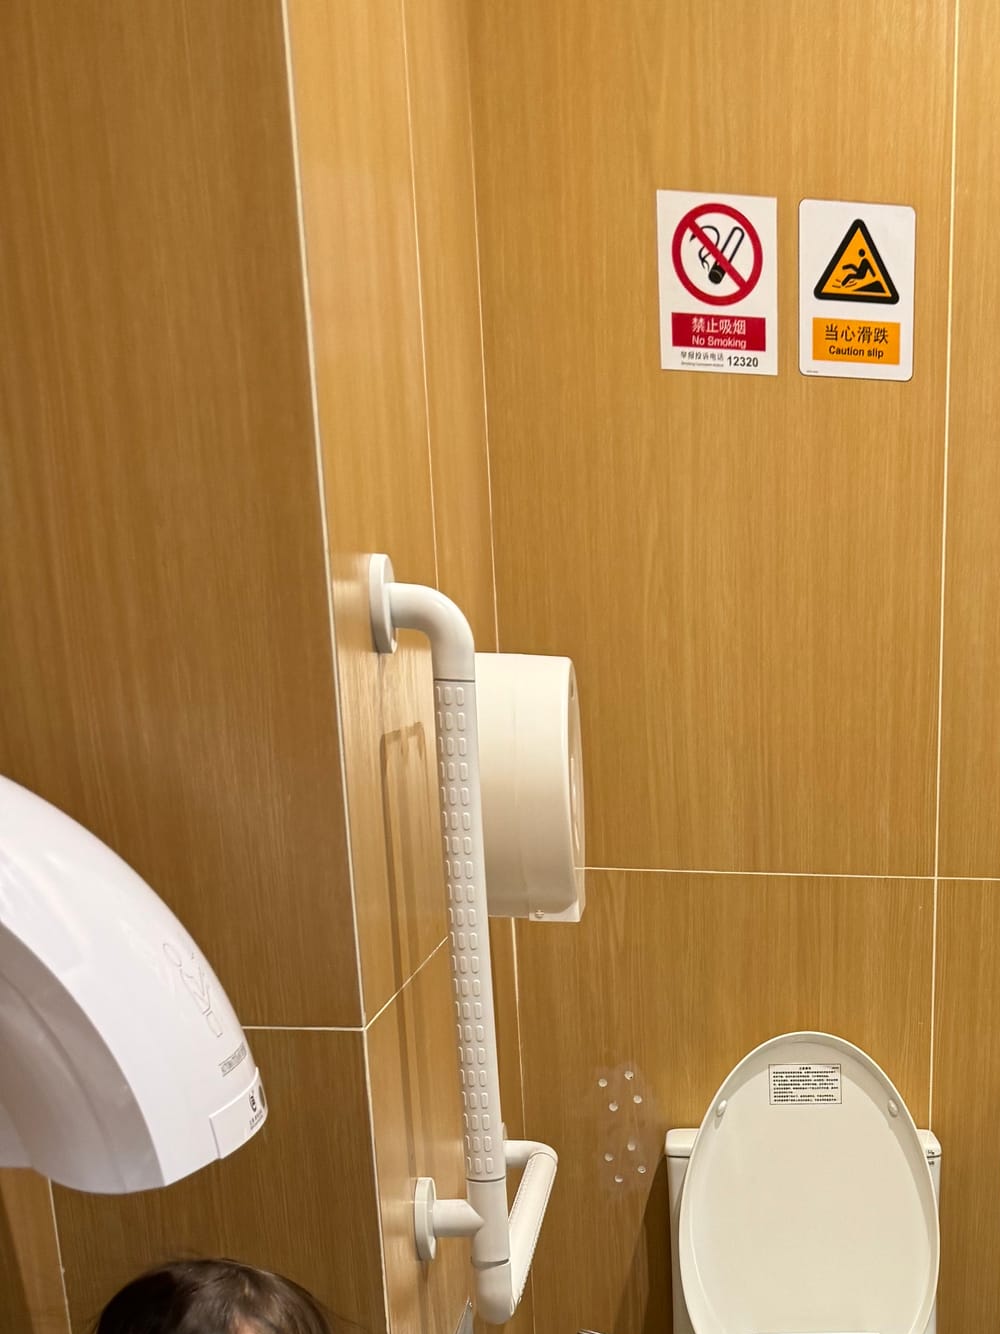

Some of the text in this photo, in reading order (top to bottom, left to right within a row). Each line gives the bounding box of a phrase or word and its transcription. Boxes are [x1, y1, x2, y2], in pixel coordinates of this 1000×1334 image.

[692, 317, 746, 335] 禁止吸烟
[825, 324, 889, 344] 当心滑跌
[692, 335, 747, 349] No Smoking
[828, 345, 884, 360] Caution slip
[727, 355, 759, 368] 12320
